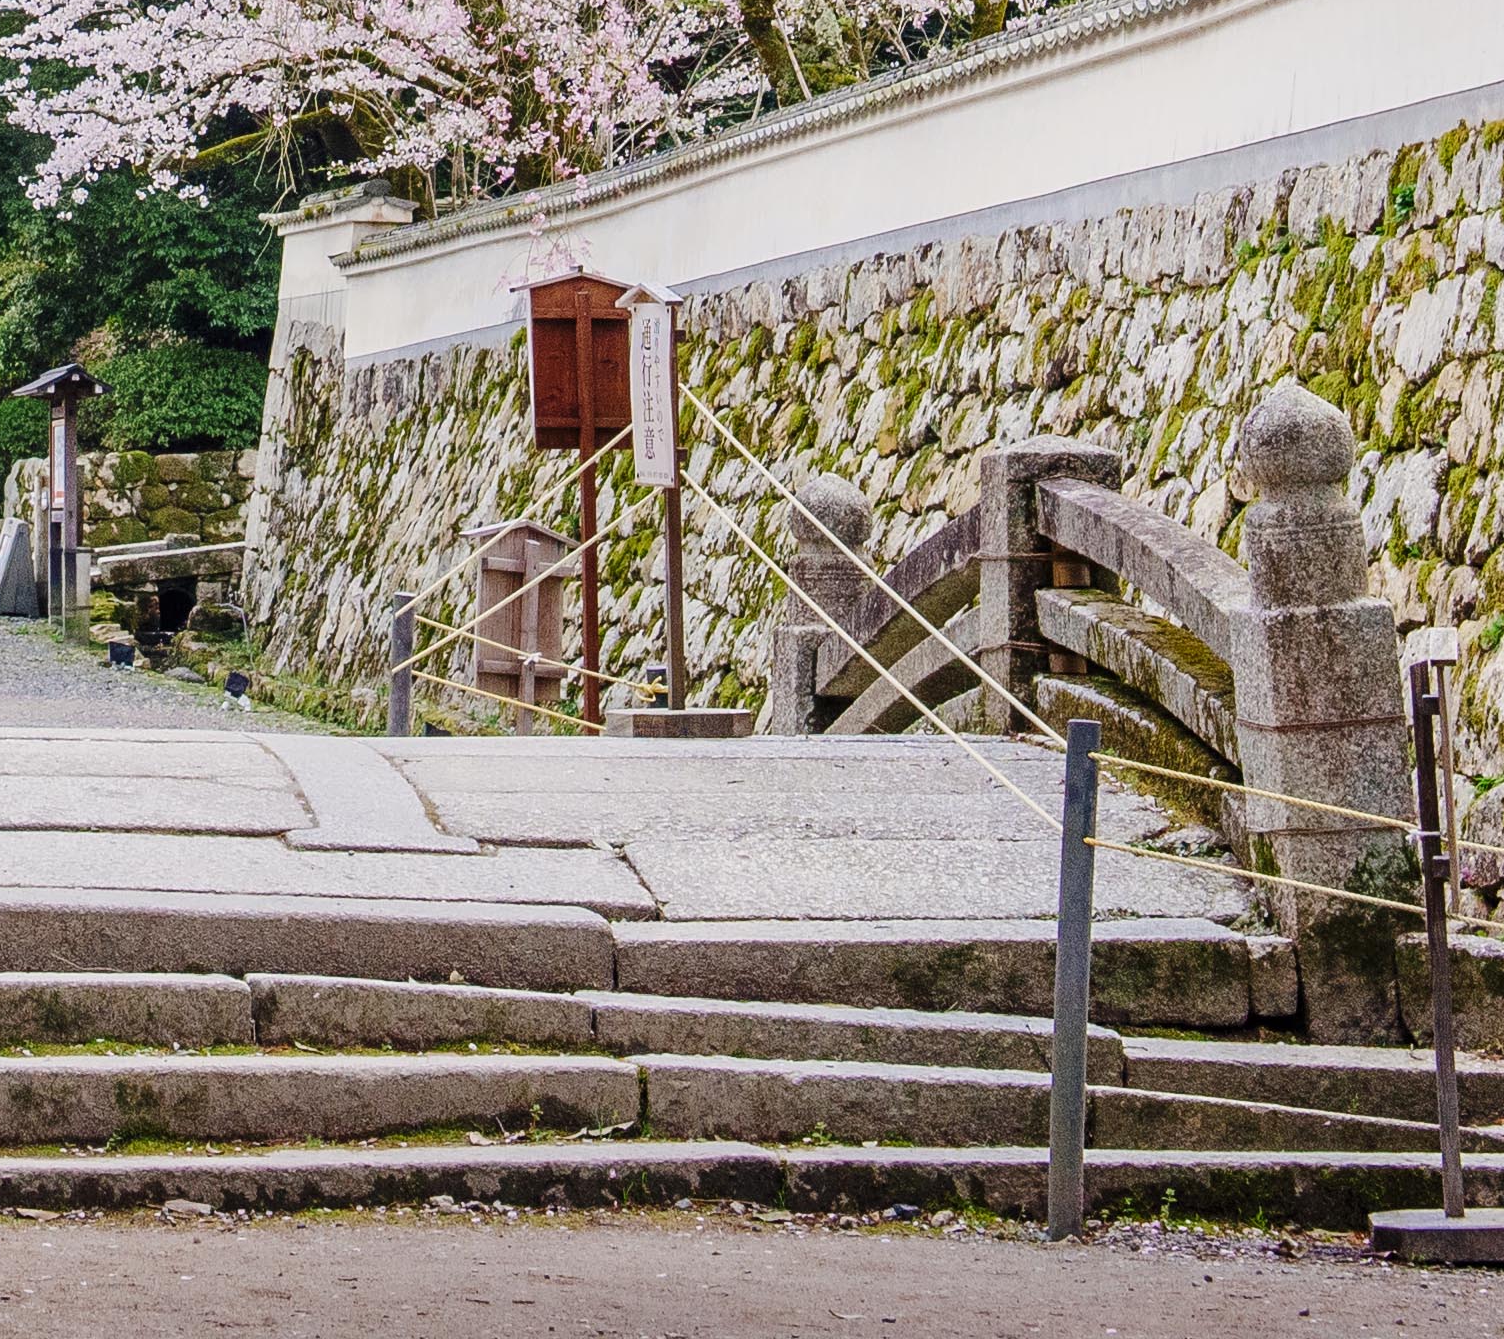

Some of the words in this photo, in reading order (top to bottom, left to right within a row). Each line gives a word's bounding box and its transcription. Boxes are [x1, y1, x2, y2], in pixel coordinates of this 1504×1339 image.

[640, 318, 656, 460] 通行注意
[653, 317, 665, 444] 滑りやすいので
